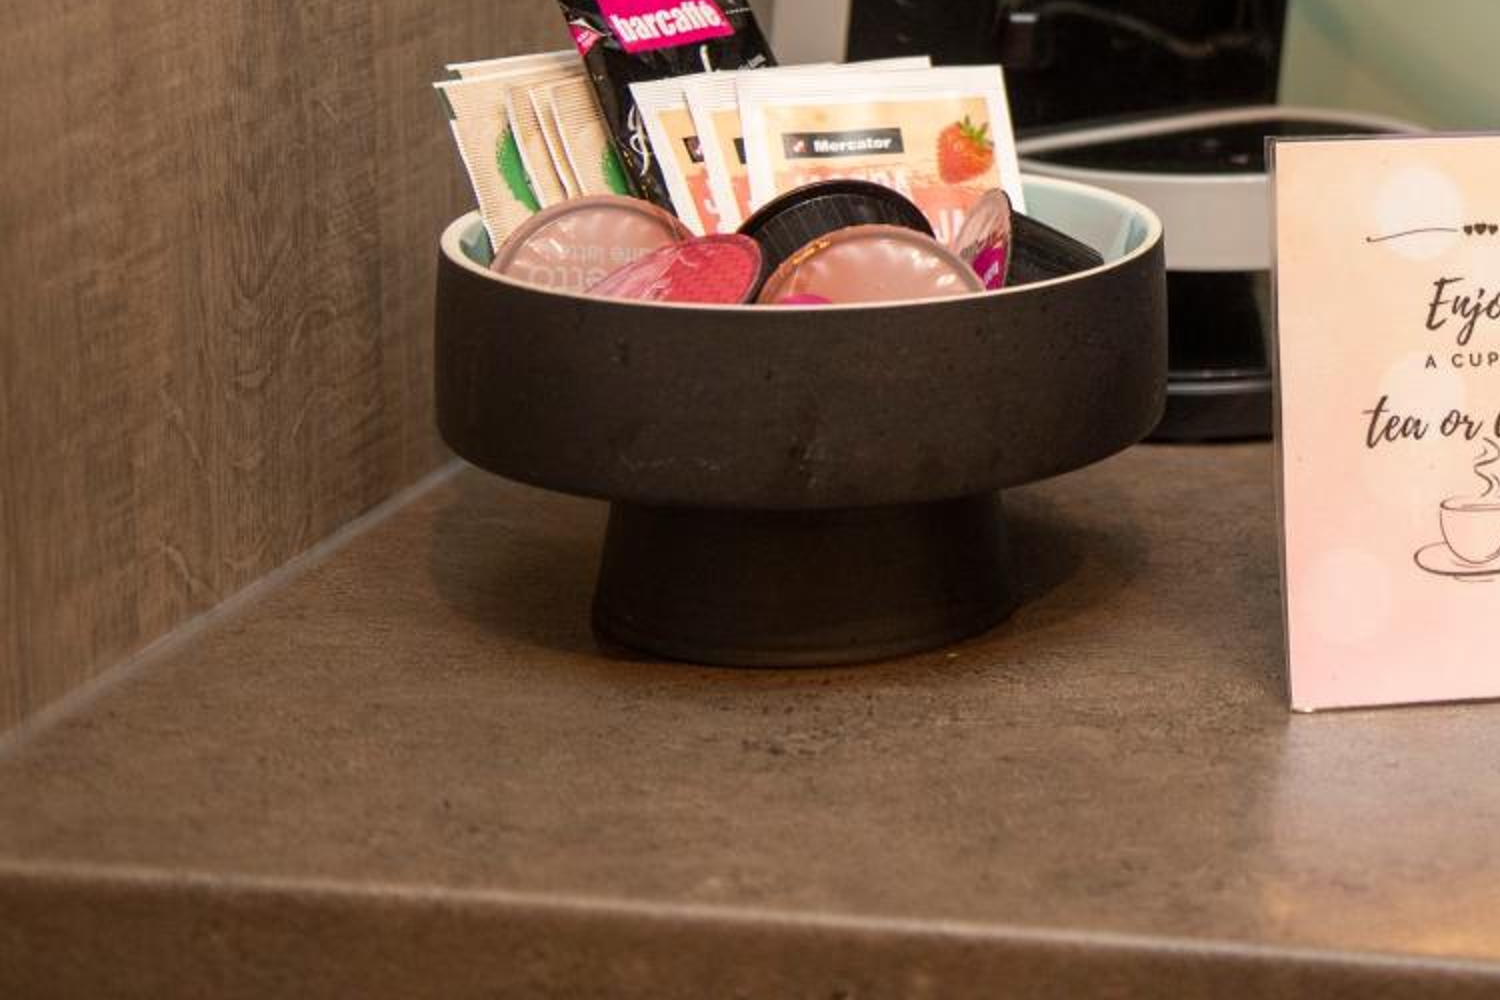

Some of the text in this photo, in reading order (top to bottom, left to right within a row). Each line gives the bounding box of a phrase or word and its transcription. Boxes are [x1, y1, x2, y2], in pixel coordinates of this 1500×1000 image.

[812, 136, 893, 153] Mercator
[1425, 354, 1437, 369] A
[1451, 351, 1499, 368] CUP
[1362, 395, 1429, 448] tea
[1439, 409, 1483, 440] or
